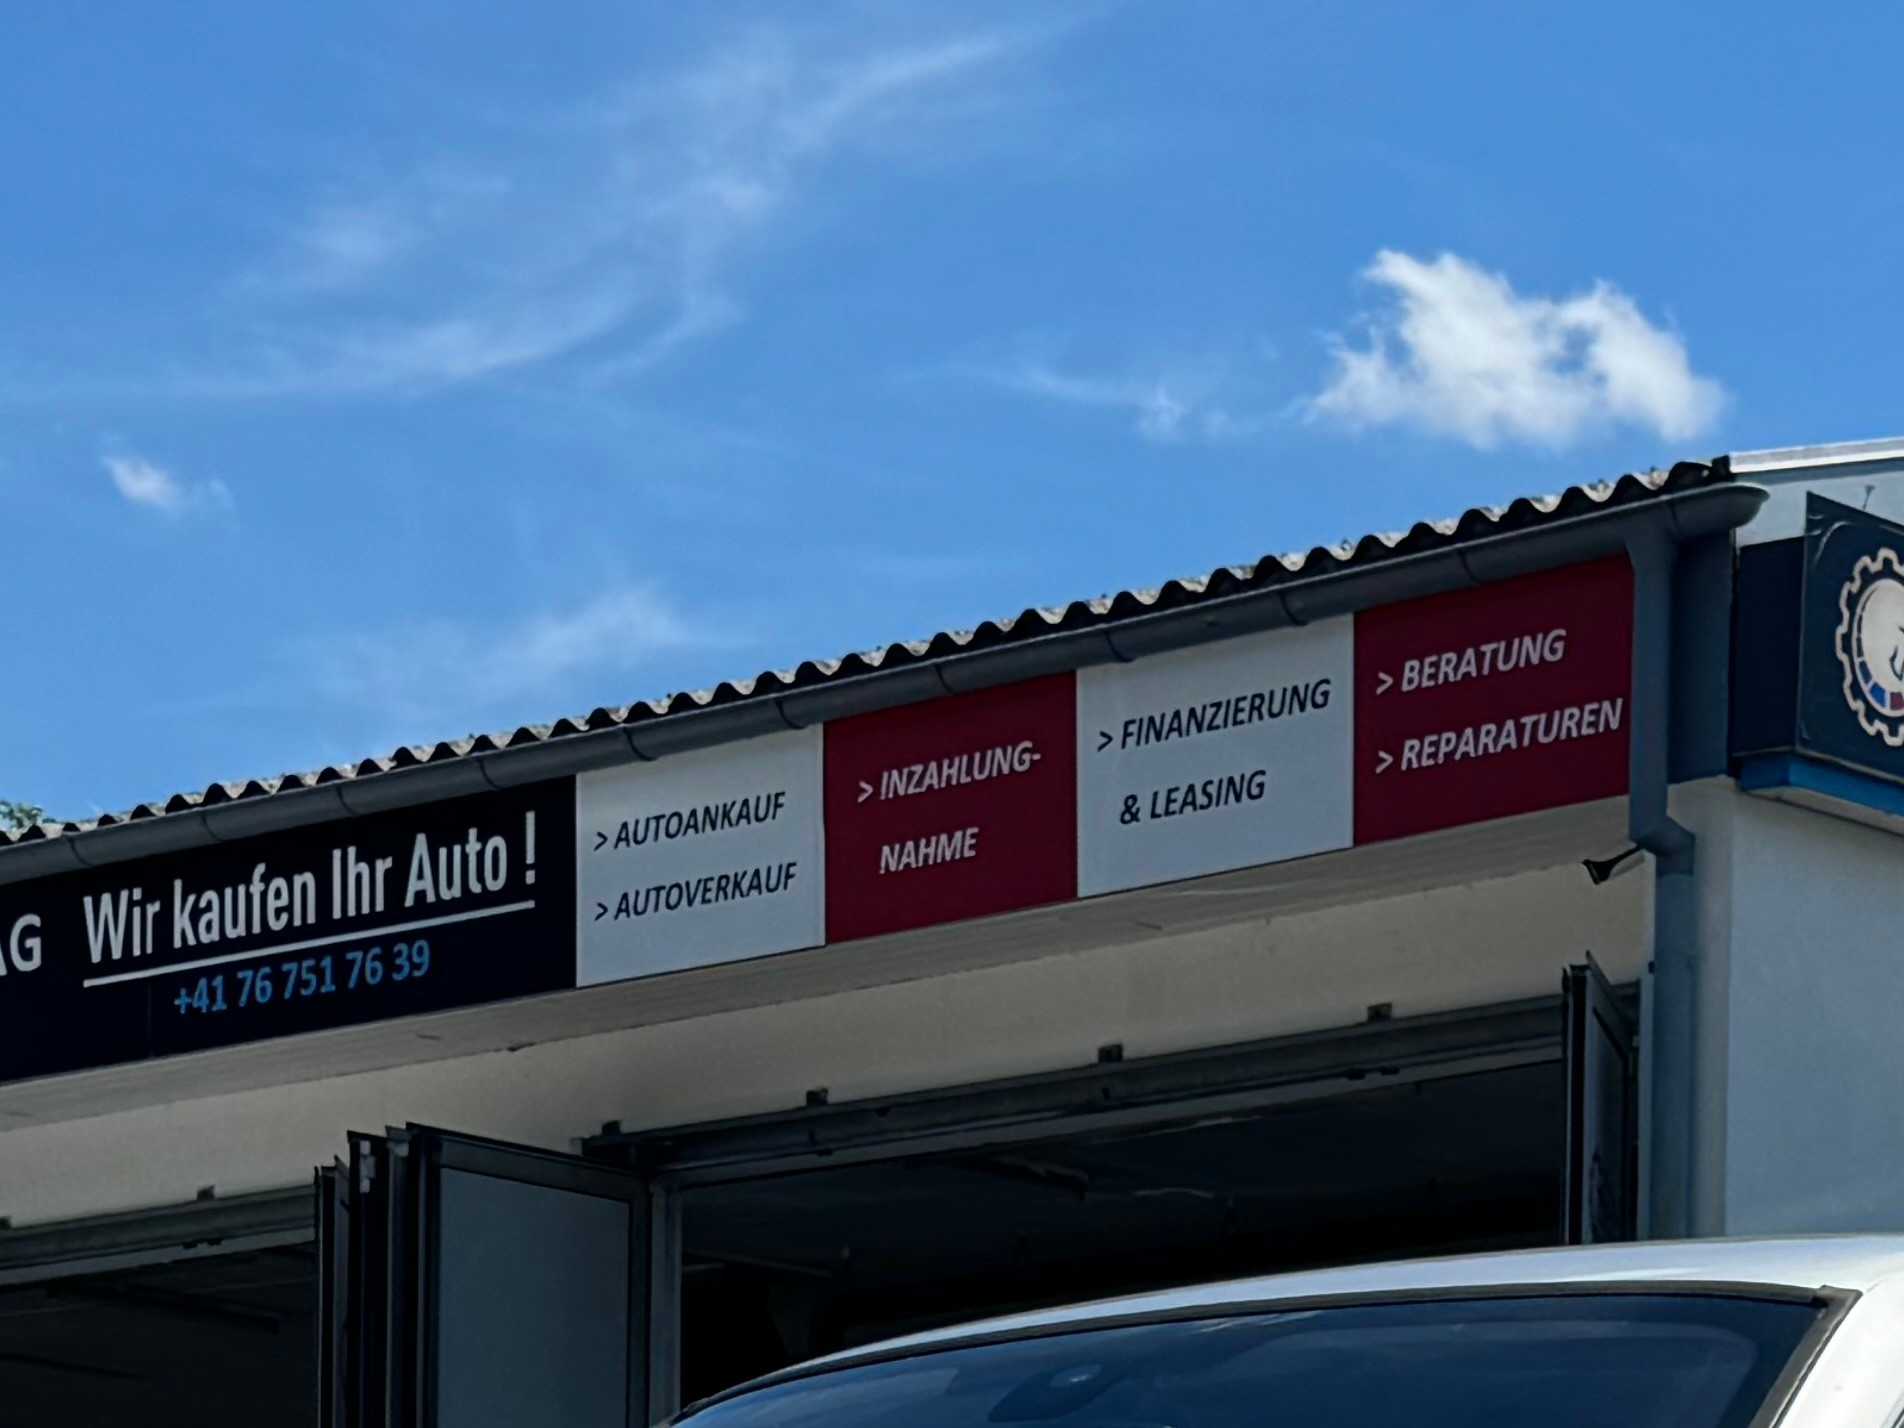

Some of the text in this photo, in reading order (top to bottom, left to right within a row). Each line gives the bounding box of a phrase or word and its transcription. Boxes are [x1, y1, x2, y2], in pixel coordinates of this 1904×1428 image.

[1399, 628, 1567, 692] BERATUNG
[1120, 679, 1332, 751] FINANZIERUNG
[1399, 698, 1623, 772] REPARATUREN
[879, 740, 1042, 801] INZAHLUNG-
[1118, 769, 1267, 826] & LEASING
[613, 791, 787, 851] AUTOANKAUF
[878, 827, 979, 875] NAHME
[82, 886, 161, 964] Wir
[172, 862, 316, 949] kaufen
[331, 845, 393, 920] Ihr
[404, 826, 508, 908] Auto
[613, 861, 798, 921] AUTOVERKAUF
[173, 939, 431, 1015] +41 76 751 76 39
